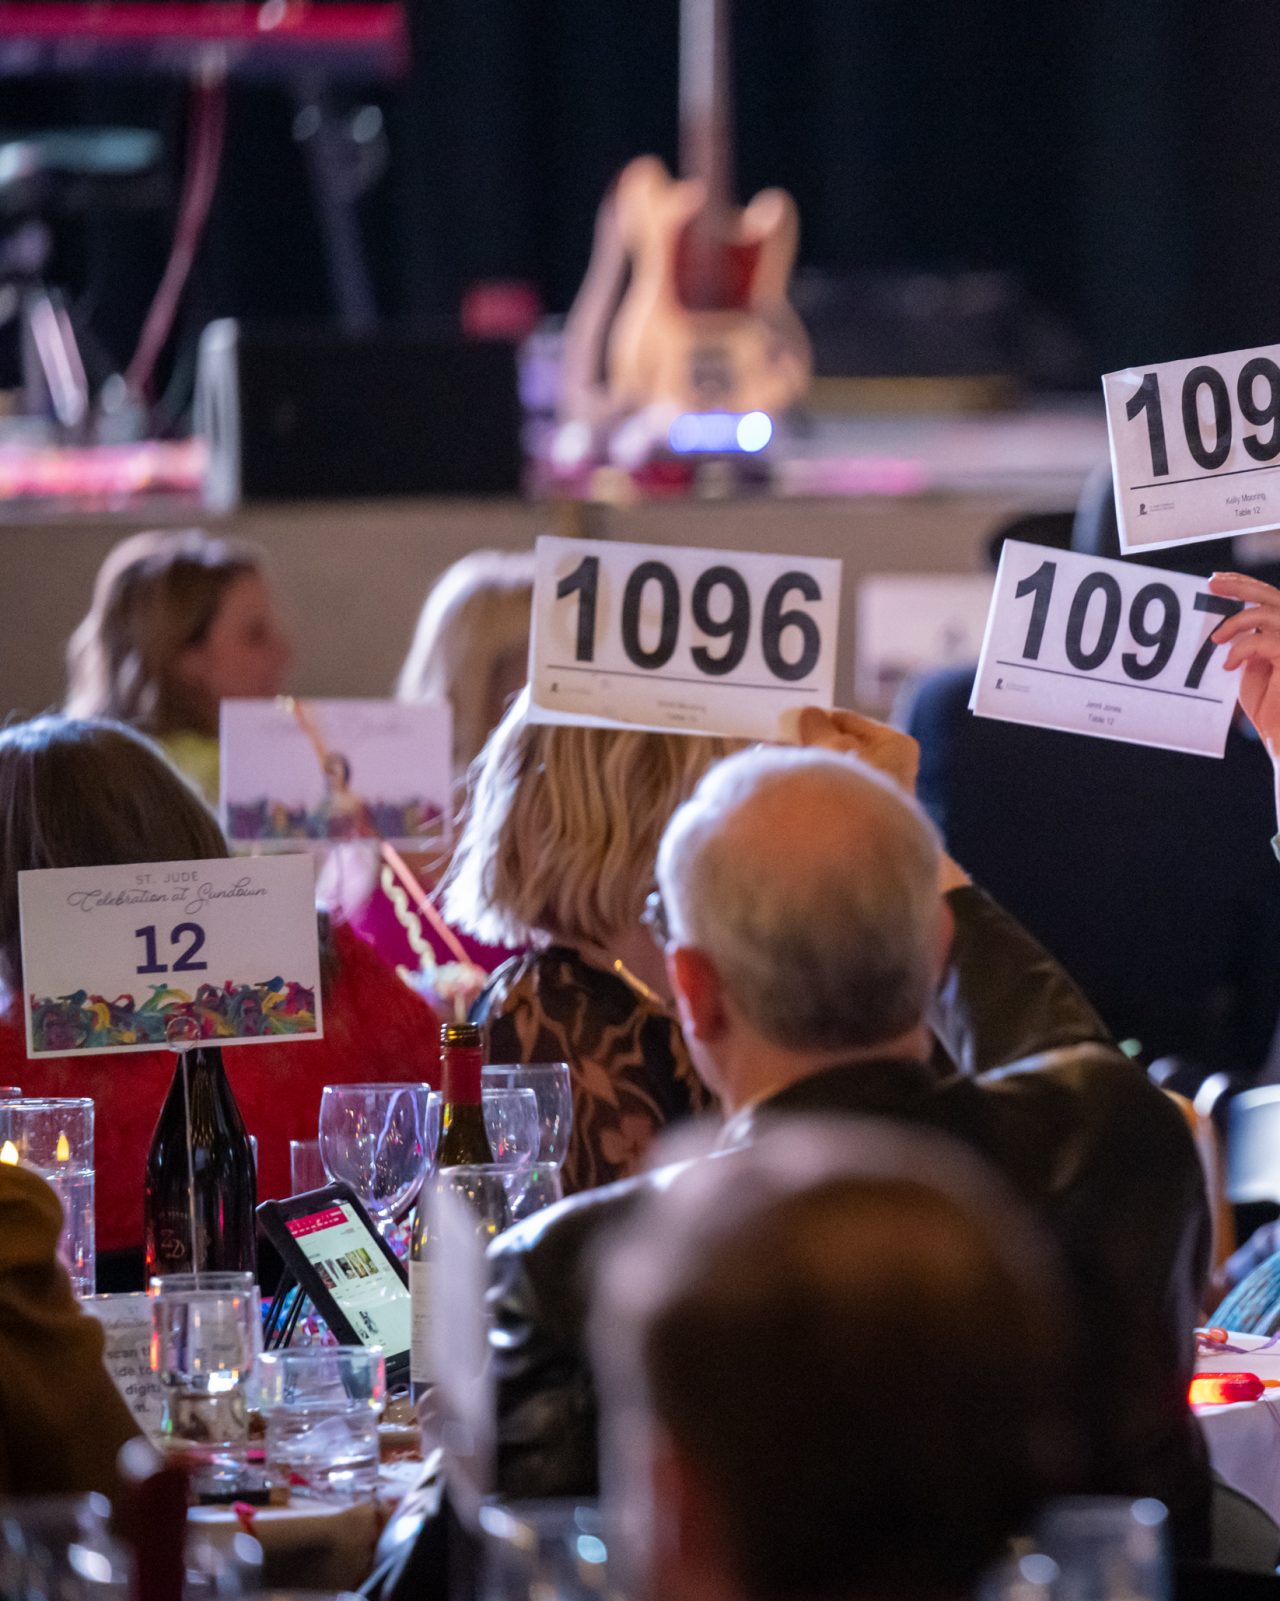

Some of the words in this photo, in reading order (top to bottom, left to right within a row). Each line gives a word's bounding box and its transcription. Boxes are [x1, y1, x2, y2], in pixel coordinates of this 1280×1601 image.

[1235, 508, 1251, 517] Table
[1253, 506, 1261, 514] 12
[556, 556, 822, 681] 1096
[1015, 561, 1245, 689] 1097
[67, 889, 169, 912] Celebration
[171, 887, 189, 901] at
[185, 877, 267, 915] Sundown
[135, 874, 156, 885] ST.
[163, 871, 199, 884] JUDE
[135, 922, 207, 974] 12
